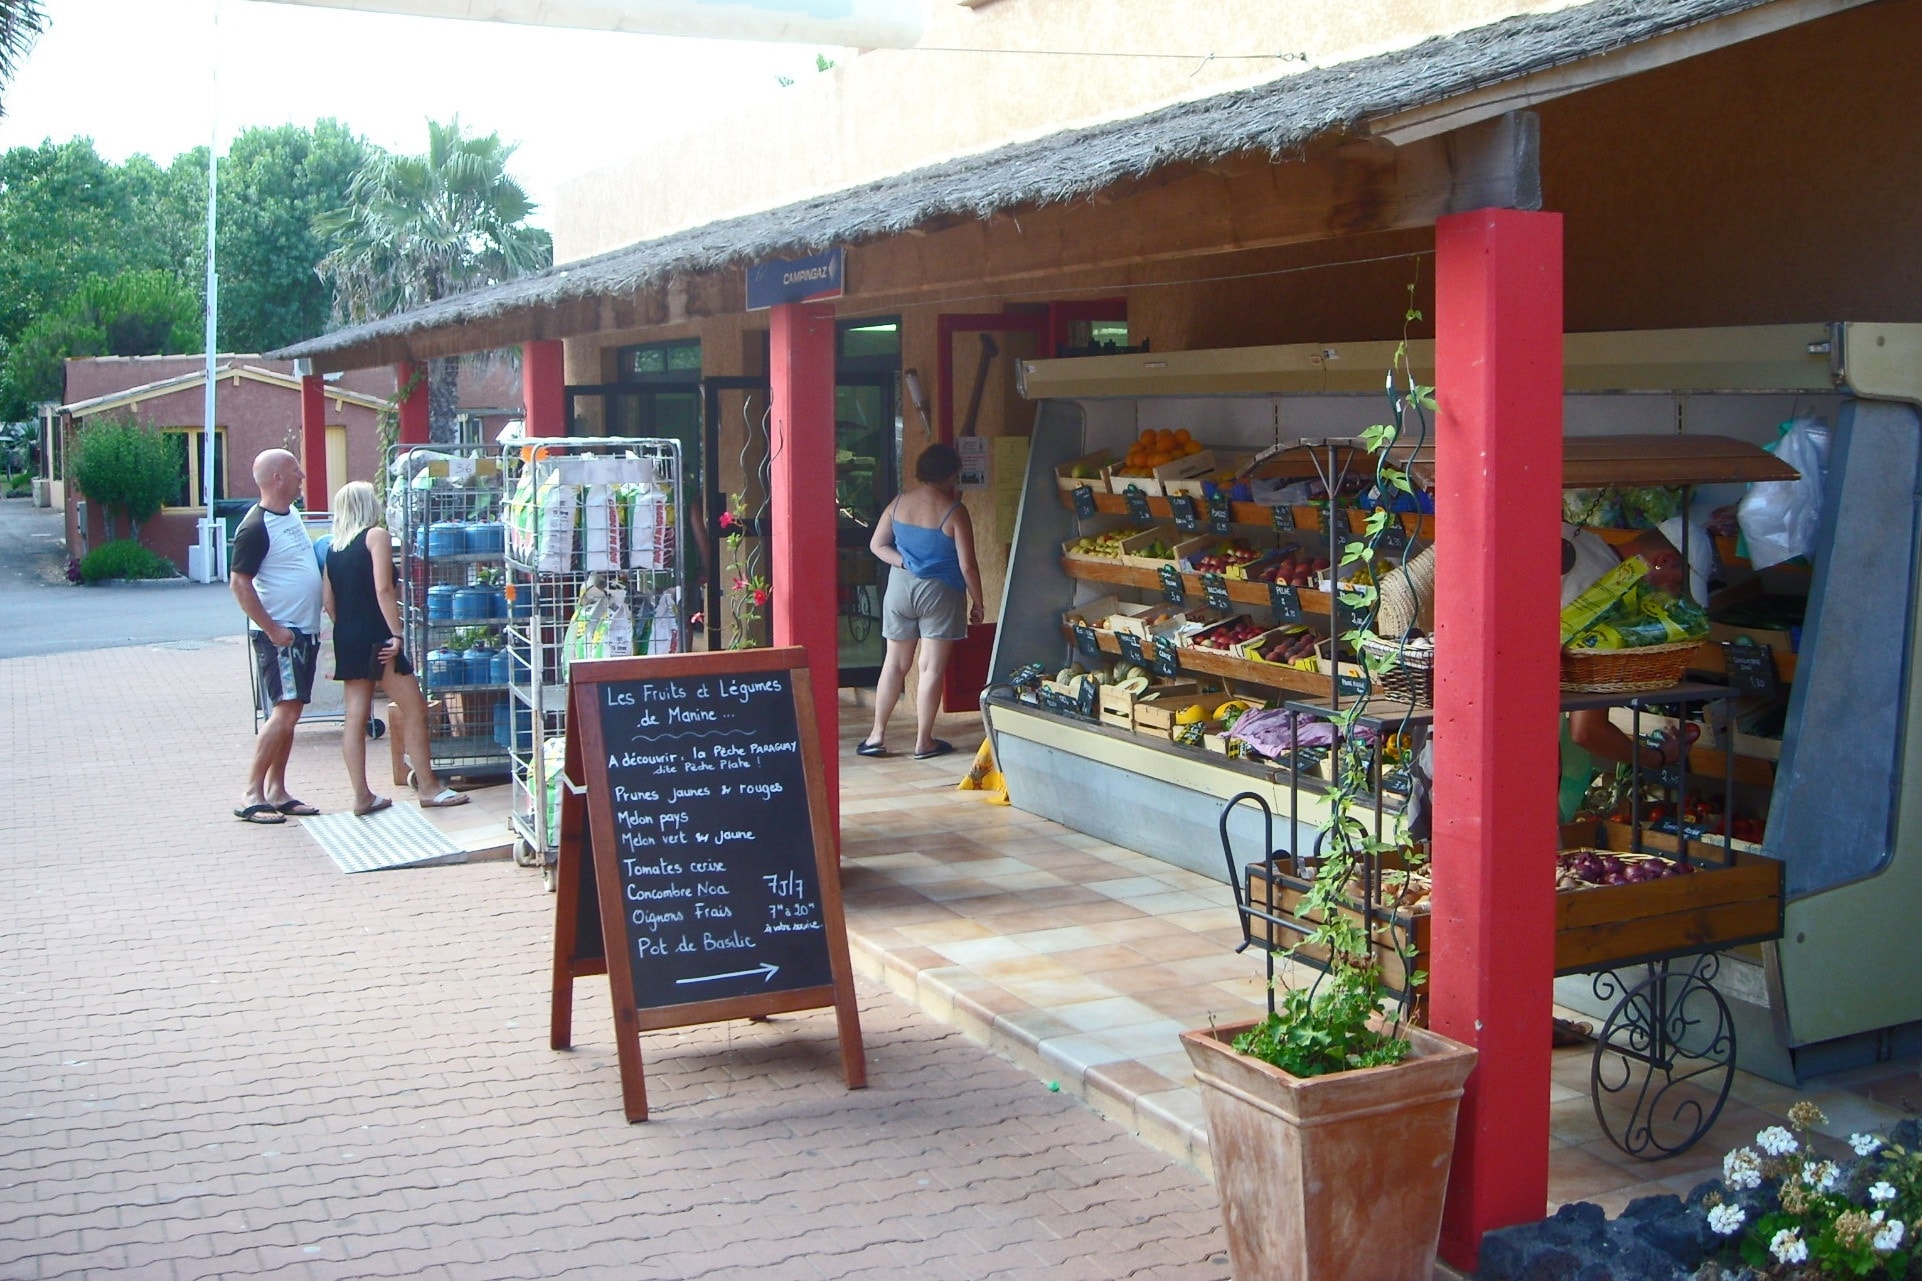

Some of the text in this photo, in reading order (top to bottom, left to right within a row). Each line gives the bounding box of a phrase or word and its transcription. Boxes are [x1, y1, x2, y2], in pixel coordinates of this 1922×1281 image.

[783, 266, 828, 285] CAMPINGAZ
[607, 679, 782, 706] Les Fruits et Légumes
[639, 708, 660, 727] de
[608, 754, 619, 769] A
[692, 746, 707, 759] la
[750, 740, 797, 754] PARAGUAY
[653, 762, 678, 775] dite
[614, 786, 660, 803] Prunes
[739, 782, 784, 801] rouges
[617, 810, 689, 832] Melon pays
[621, 832, 656, 853] Melon
[662, 832, 688, 845] vert
[623, 857, 727, 877] Tomates cerise
[627, 881, 731, 901] Concombre Noa
[632, 902, 733, 933] Oignons Frais
[638, 930, 757, 959] Pot de Basilic
